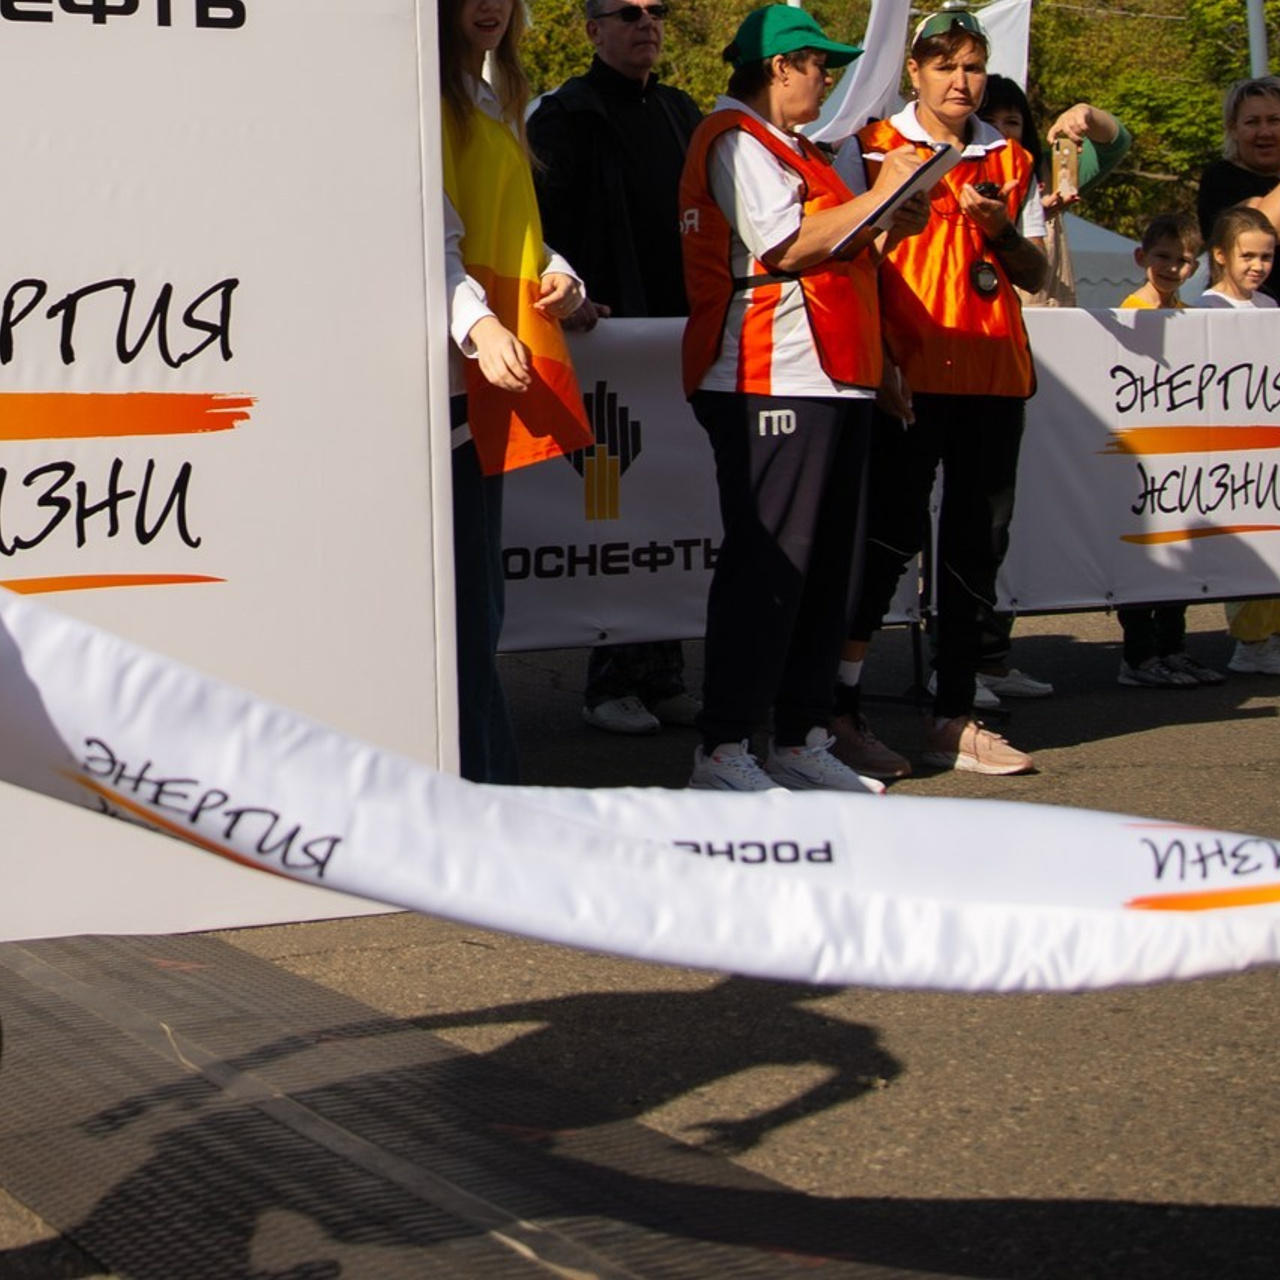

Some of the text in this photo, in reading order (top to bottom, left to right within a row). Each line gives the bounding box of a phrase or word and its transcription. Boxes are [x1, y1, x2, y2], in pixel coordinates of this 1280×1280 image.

[1110, 363, 1280, 412] ЭНЕРГИ
[758, 409, 797, 437] ГТО
[83, 737, 342, 878] ЭНЕРГИЯ
